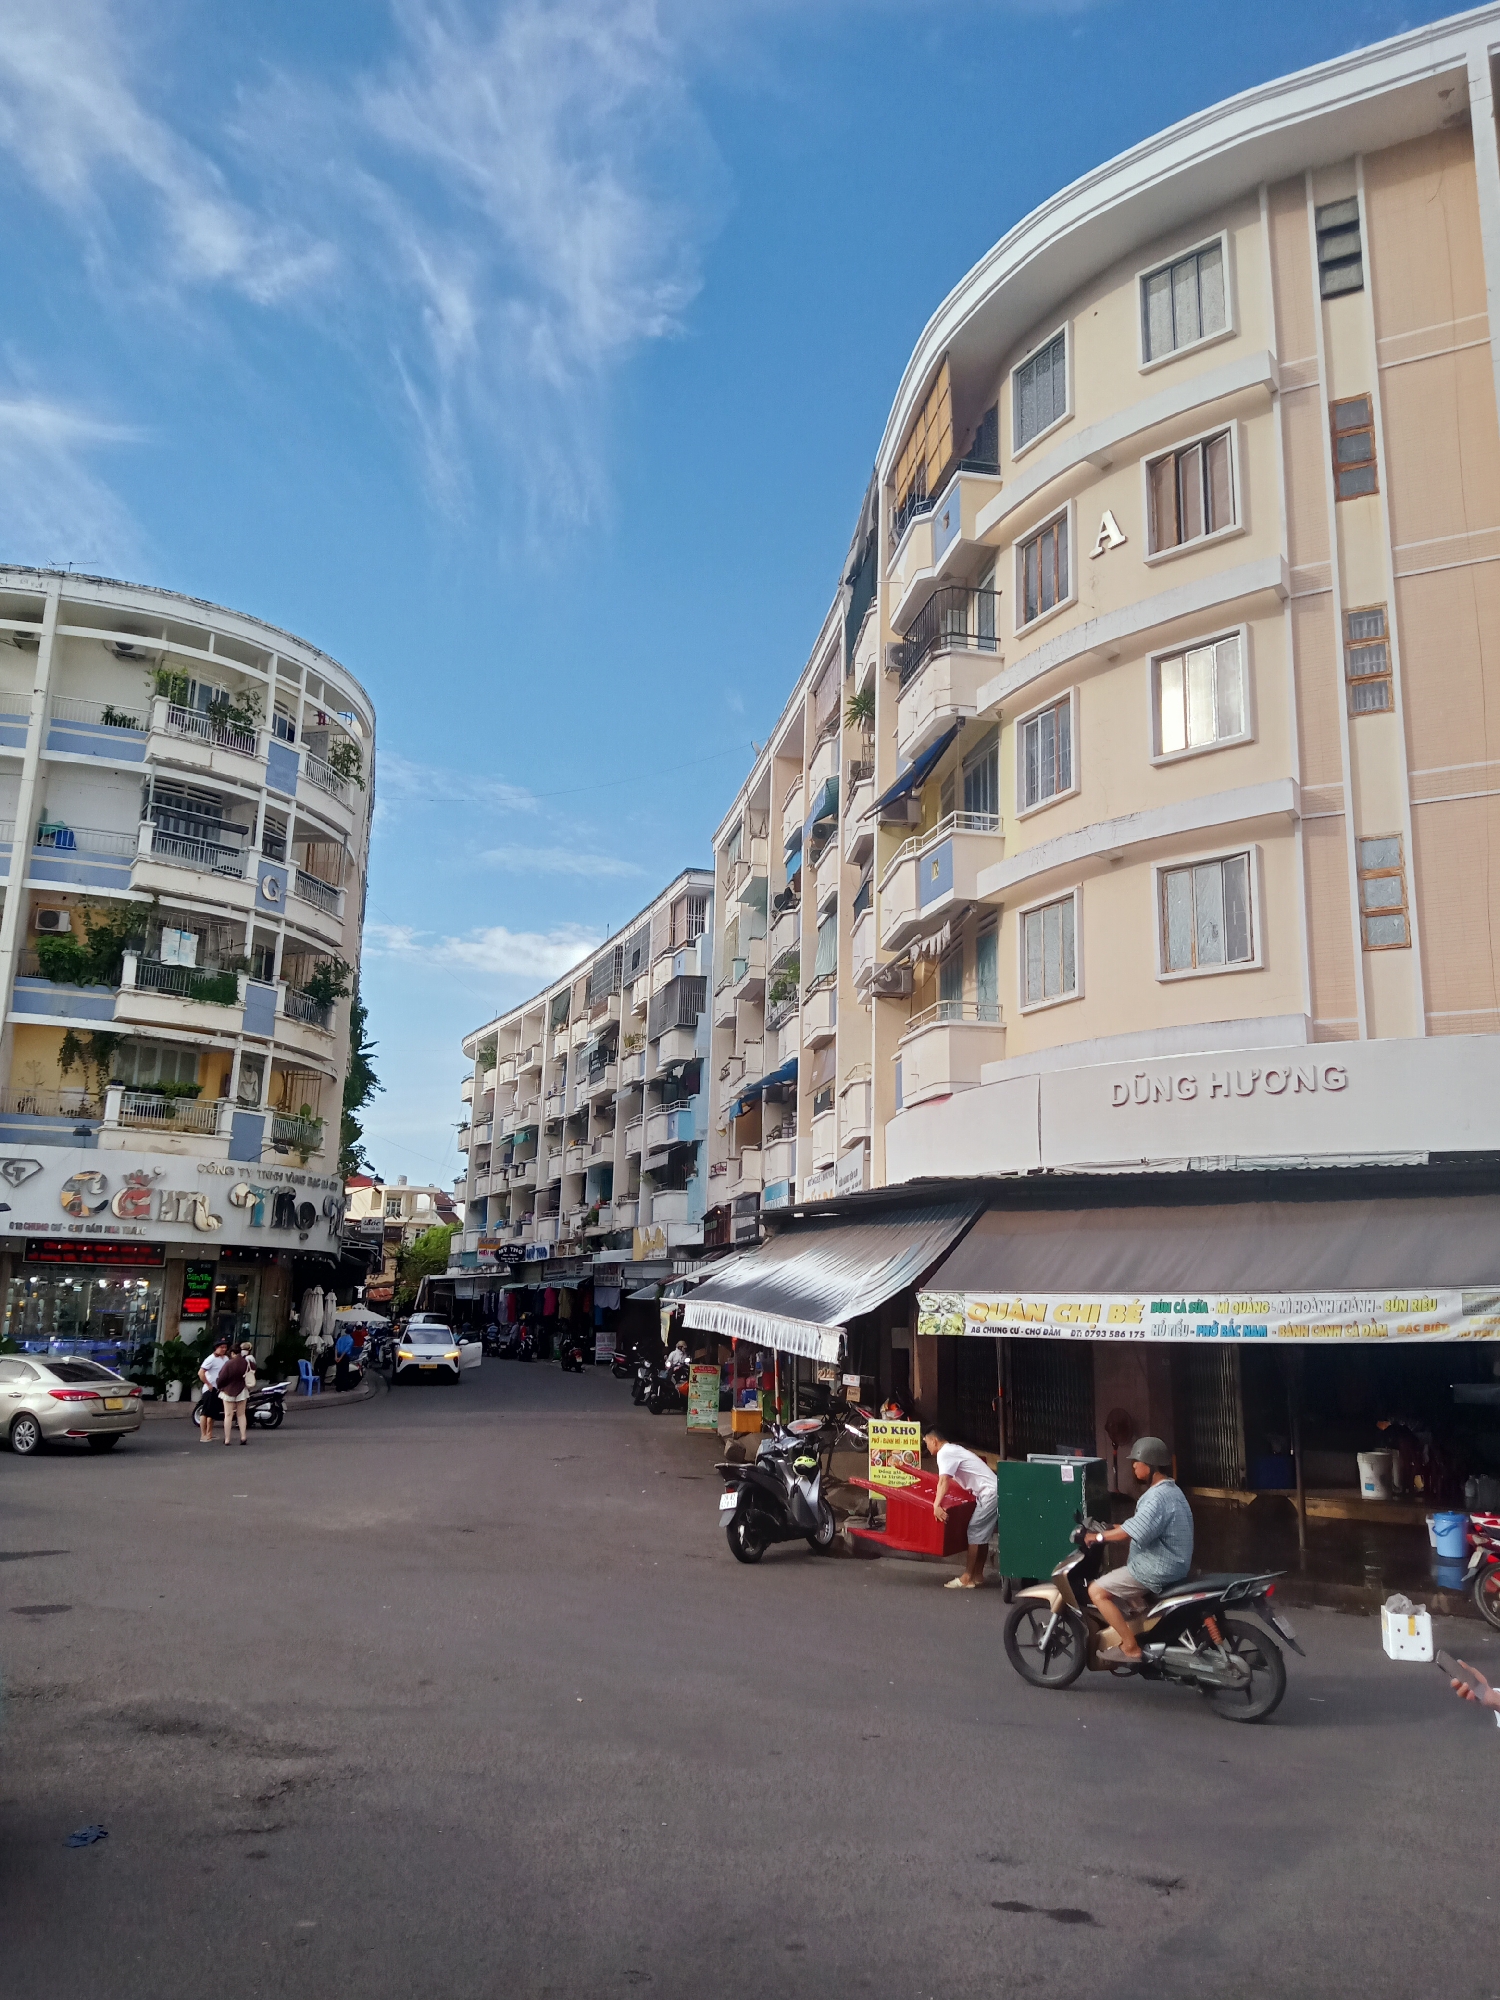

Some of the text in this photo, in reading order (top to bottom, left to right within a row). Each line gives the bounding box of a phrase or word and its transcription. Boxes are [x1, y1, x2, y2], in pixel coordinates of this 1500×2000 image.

[1089, 509, 1128, 560] A
[1112, 1064, 1349, 1107] DŨNG HƯƠNG
[967, 1297, 1048, 1324] QUÁN
[1106, 1298, 1145, 1324] BÉ
[1383, 1295, 1408, 1312] BÚN
[982, 1326, 1008, 1334] CHUNG
[1010, 1326, 1020, 1335] CƯ
[1025, 1327, 1042, 1337] CHỢ
[1084, 1330, 1106, 1338] 0793
[1242, 1325, 1267, 1337] NAM
[1278, 1321, 1309, 1337] BÁNH
[1311, 1325, 1342, 1337] CANH
[1345, 1321, 1360, 1337] CÁ
[872, 1425, 917, 1435] BÒ KHO
